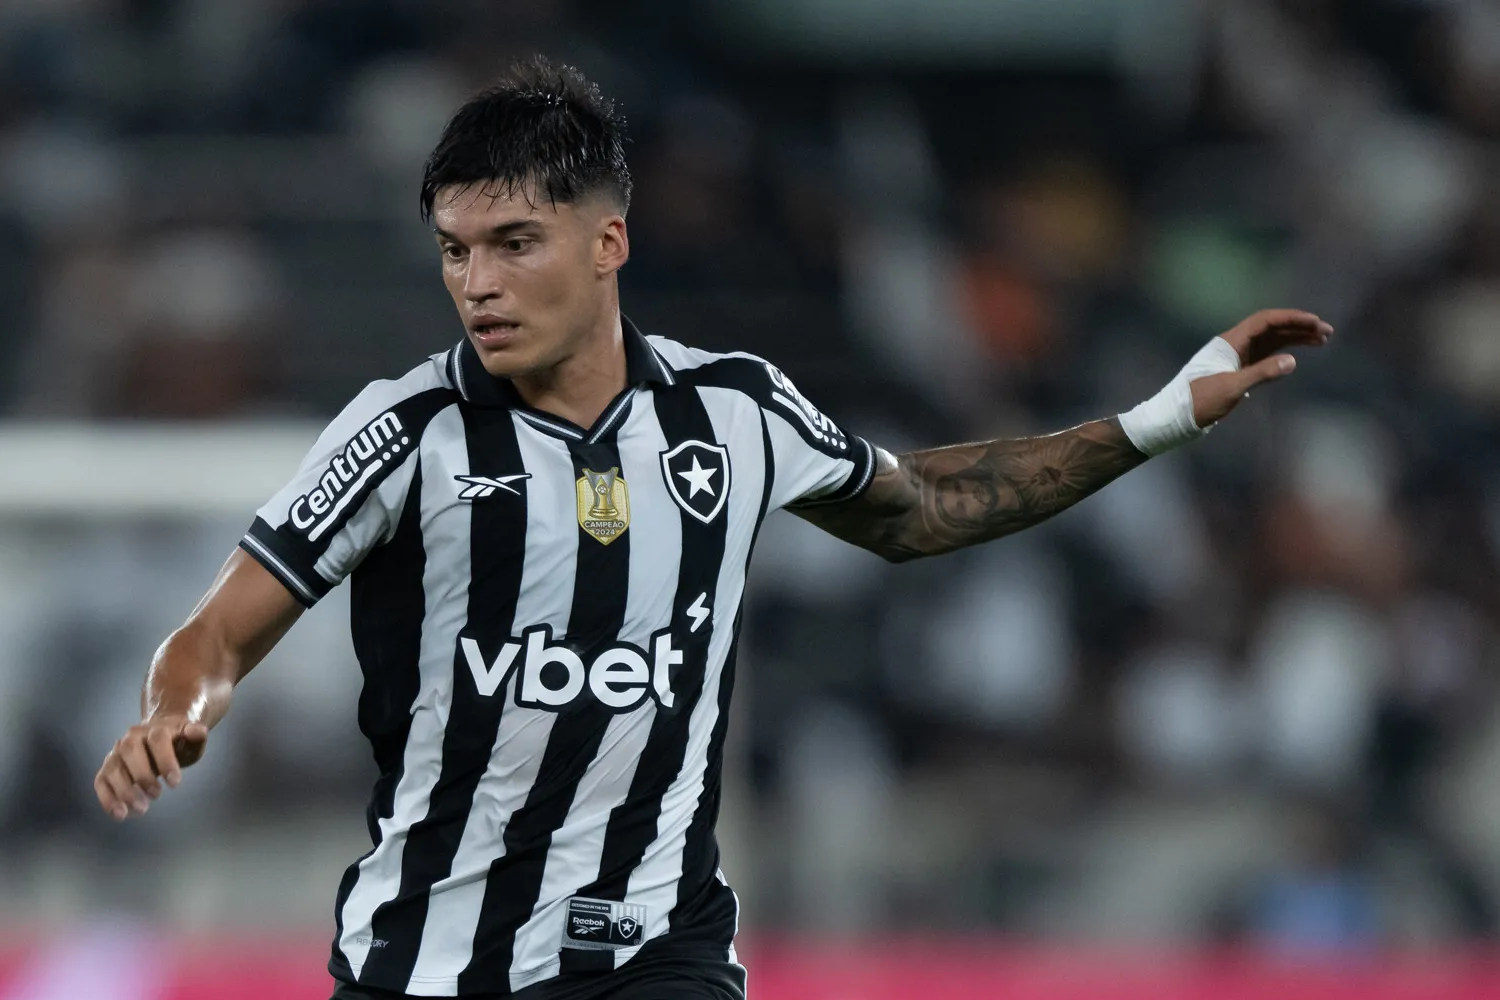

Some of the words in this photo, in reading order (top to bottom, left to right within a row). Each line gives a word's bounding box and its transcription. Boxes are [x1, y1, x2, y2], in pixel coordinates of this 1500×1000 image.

[291, 411, 403, 530] Centrum
[595, 528, 615, 536] 2024
[460, 630, 684, 708] vbet
[573, 916, 605, 927] Reebok
